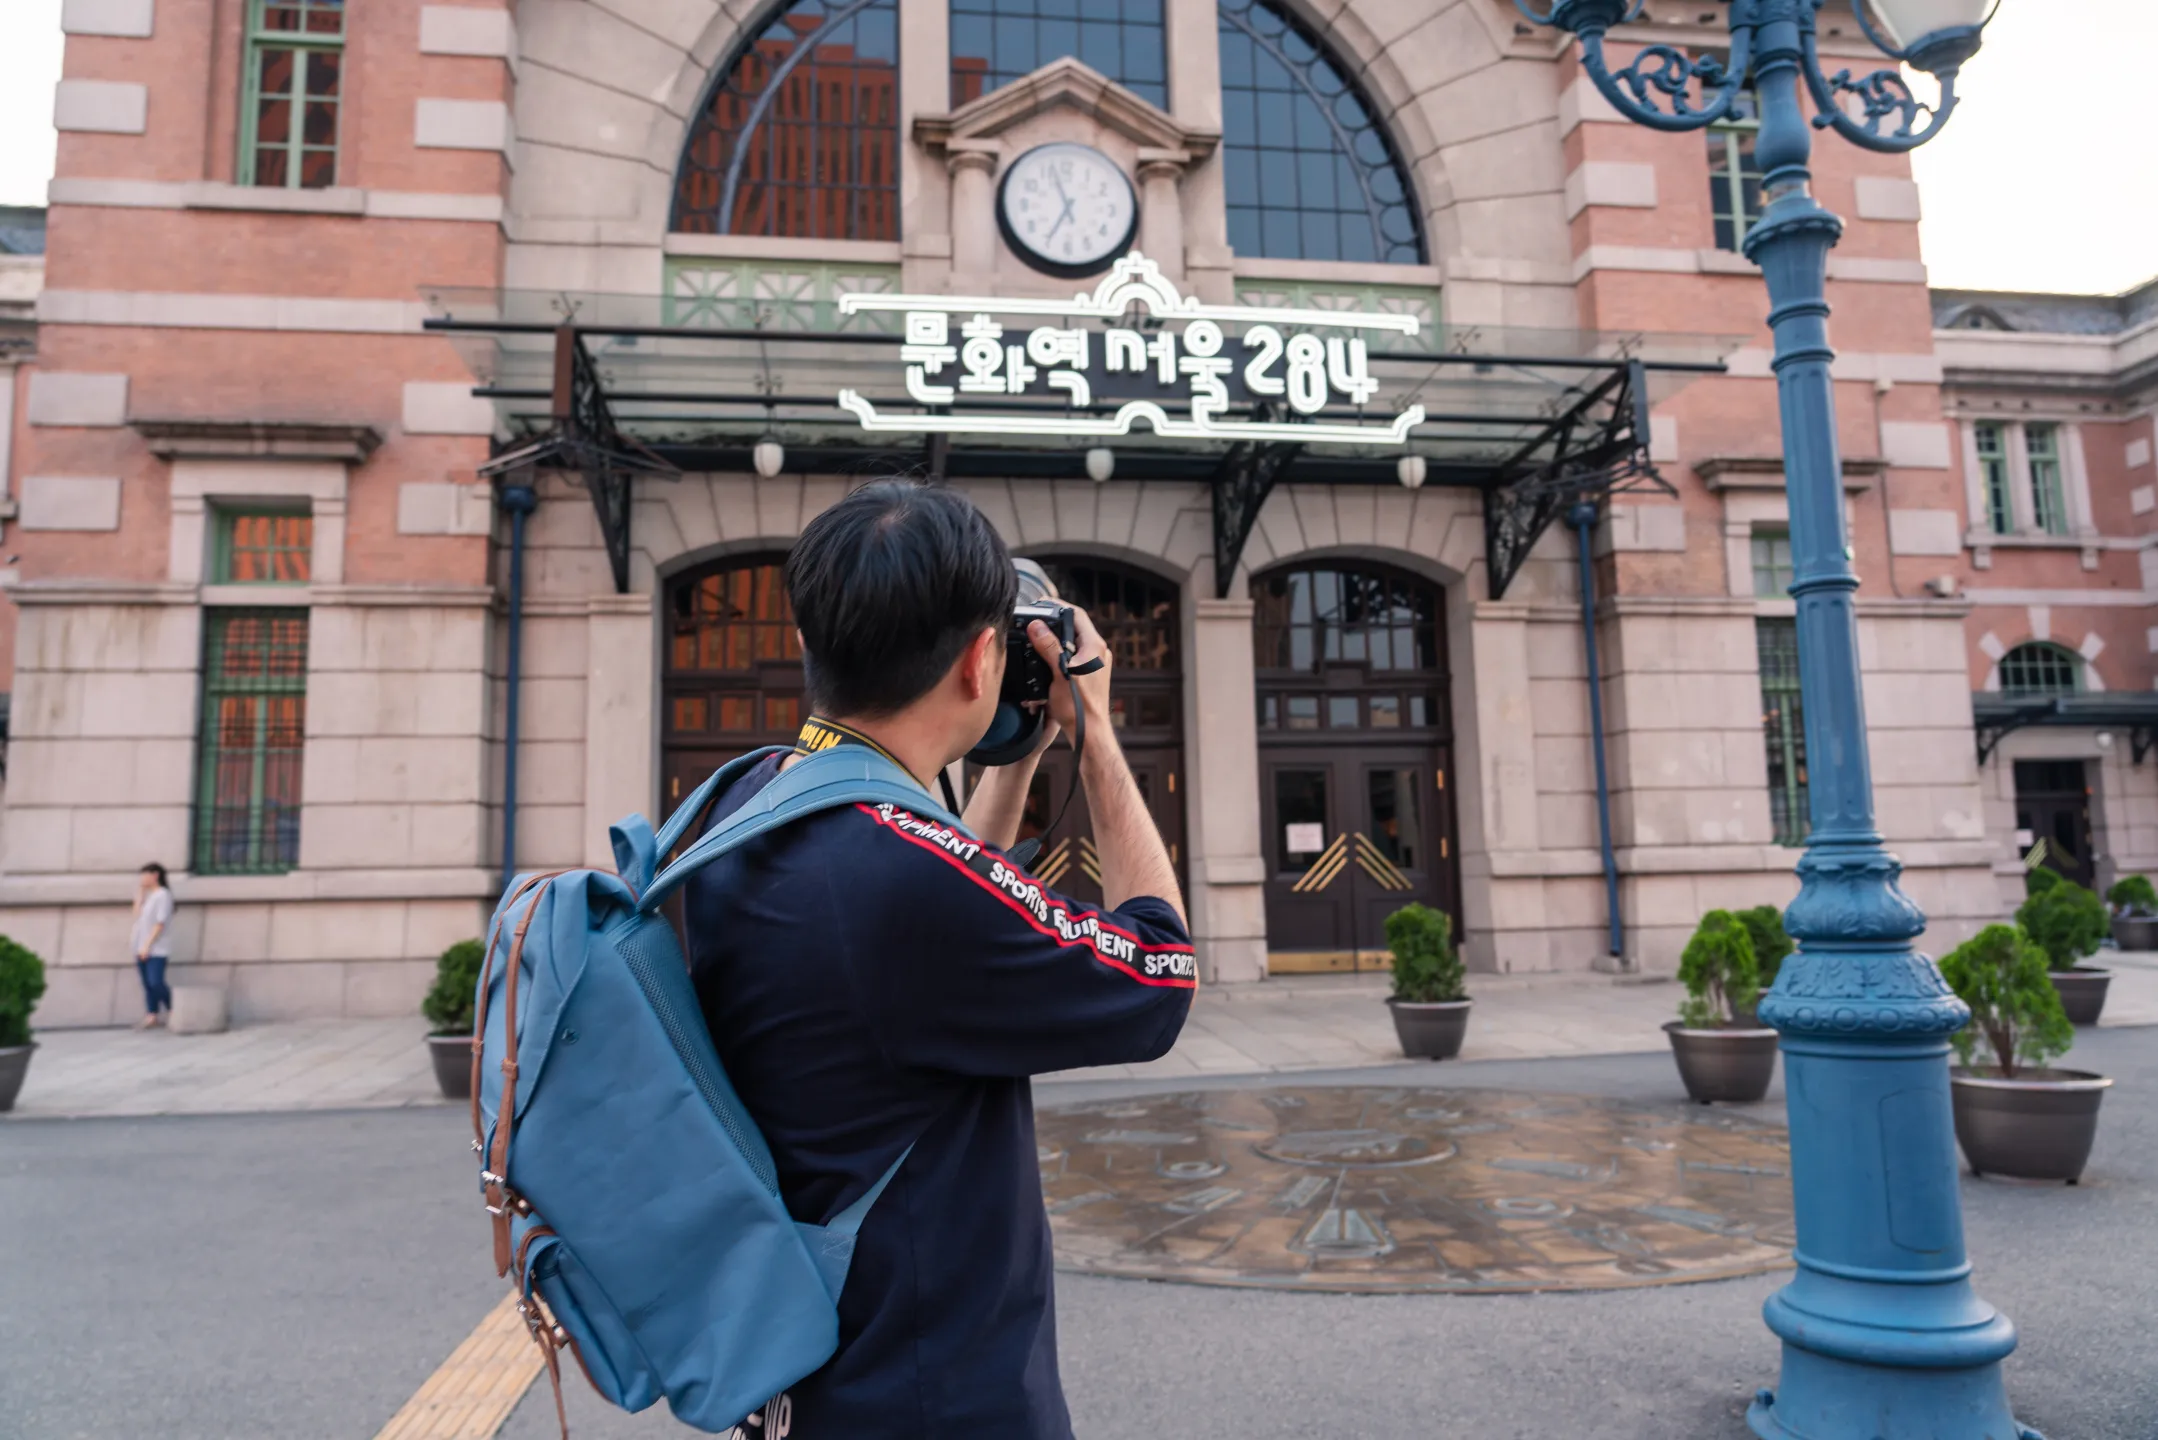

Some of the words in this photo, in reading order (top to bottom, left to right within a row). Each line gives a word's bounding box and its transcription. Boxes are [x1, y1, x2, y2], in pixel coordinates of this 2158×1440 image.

[1099, 181, 1109, 197] 2
[1243, 324, 1380, 414] 284
[989, 861, 1049, 922] SPORTS
